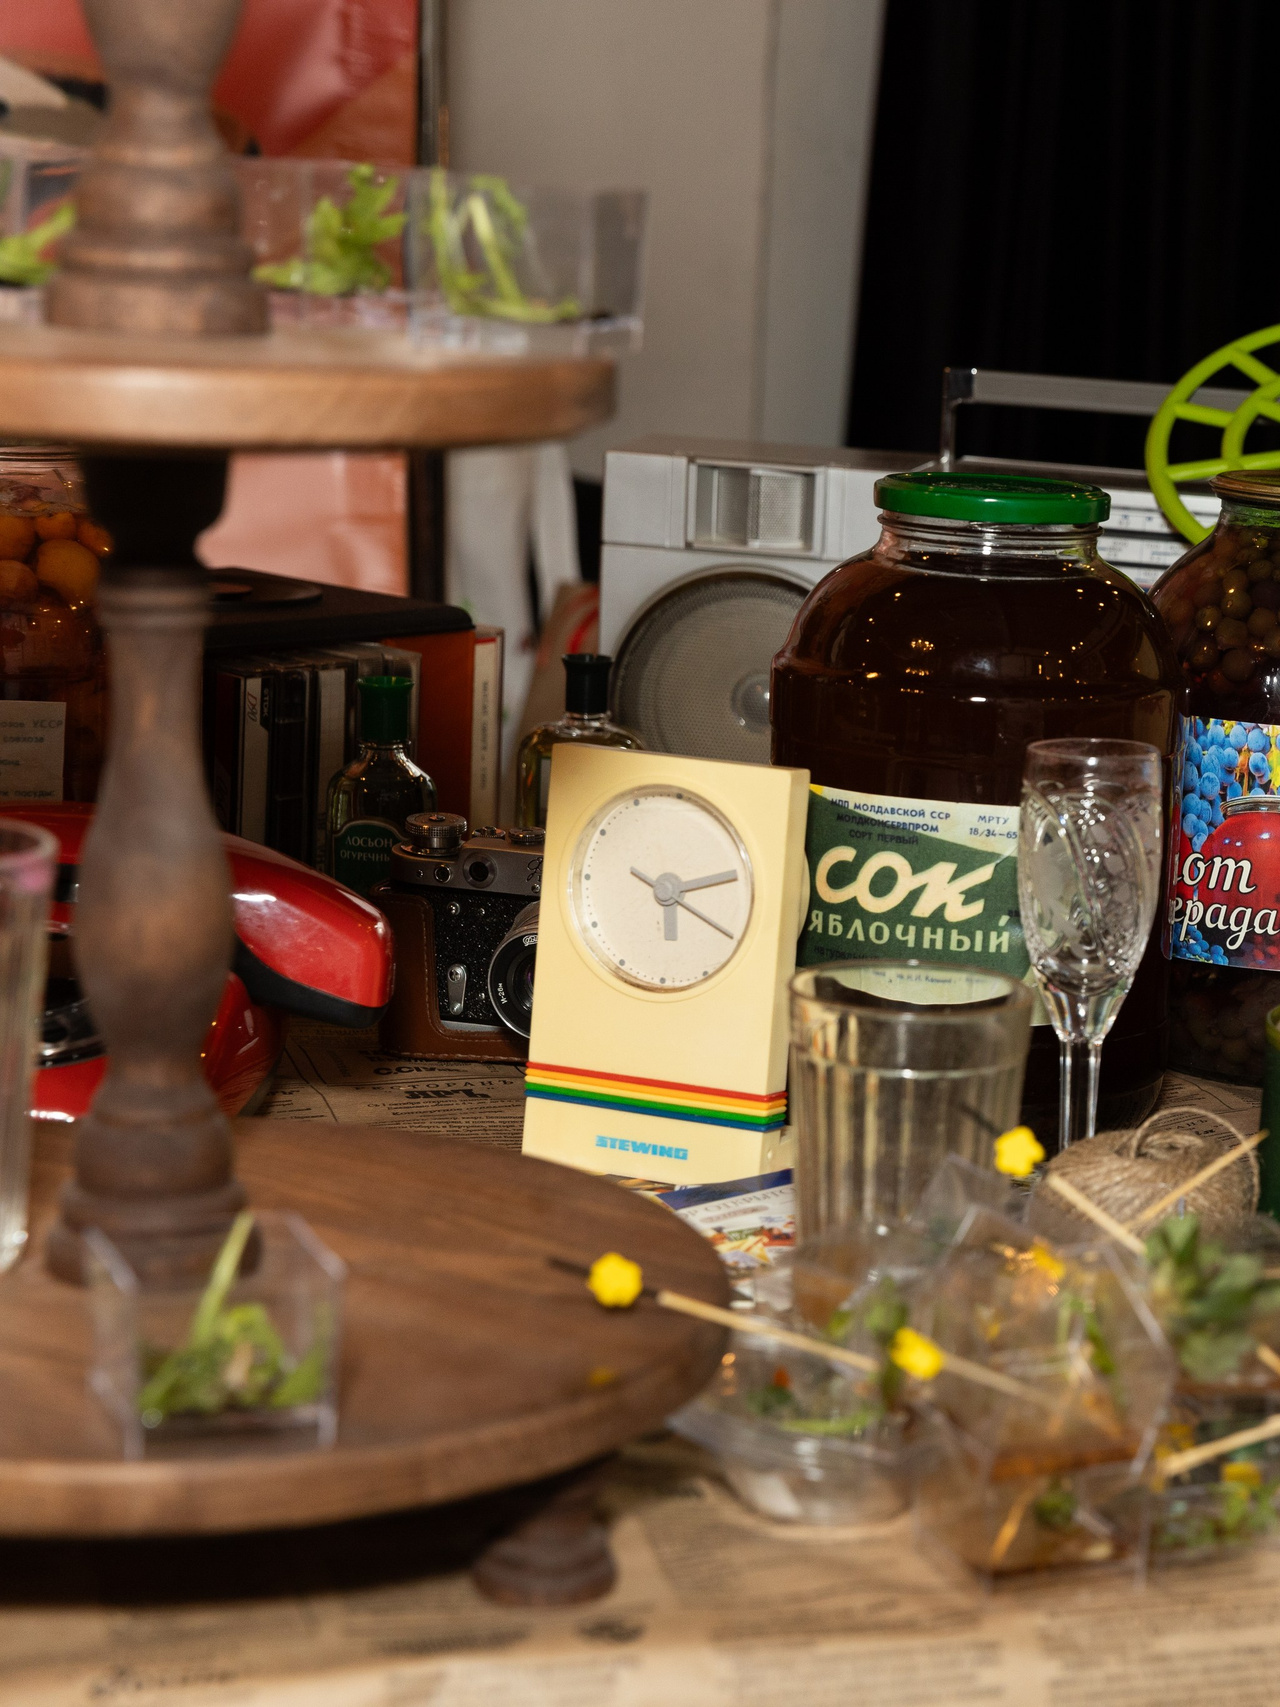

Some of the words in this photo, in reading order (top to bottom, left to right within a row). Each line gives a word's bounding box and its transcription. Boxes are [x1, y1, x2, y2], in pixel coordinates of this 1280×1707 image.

[853, 802, 926, 818] МОЛДАВСКОЙ
[930, 810, 951, 820] ССР
[977, 815, 1010, 825] МРТУ
[837, 813, 940, 833] МОЛДКОНСЕРВПРОМ
[346, 835, 393, 848] ЛОСЬОН
[849, 829, 872, 840] СОРТ
[877, 833, 919, 845] ПЕРВЫЙ
[808, 909, 1010, 954] ЯБЛОЧНЫЙ
[595, 1134, 689, 1161] STEWING
